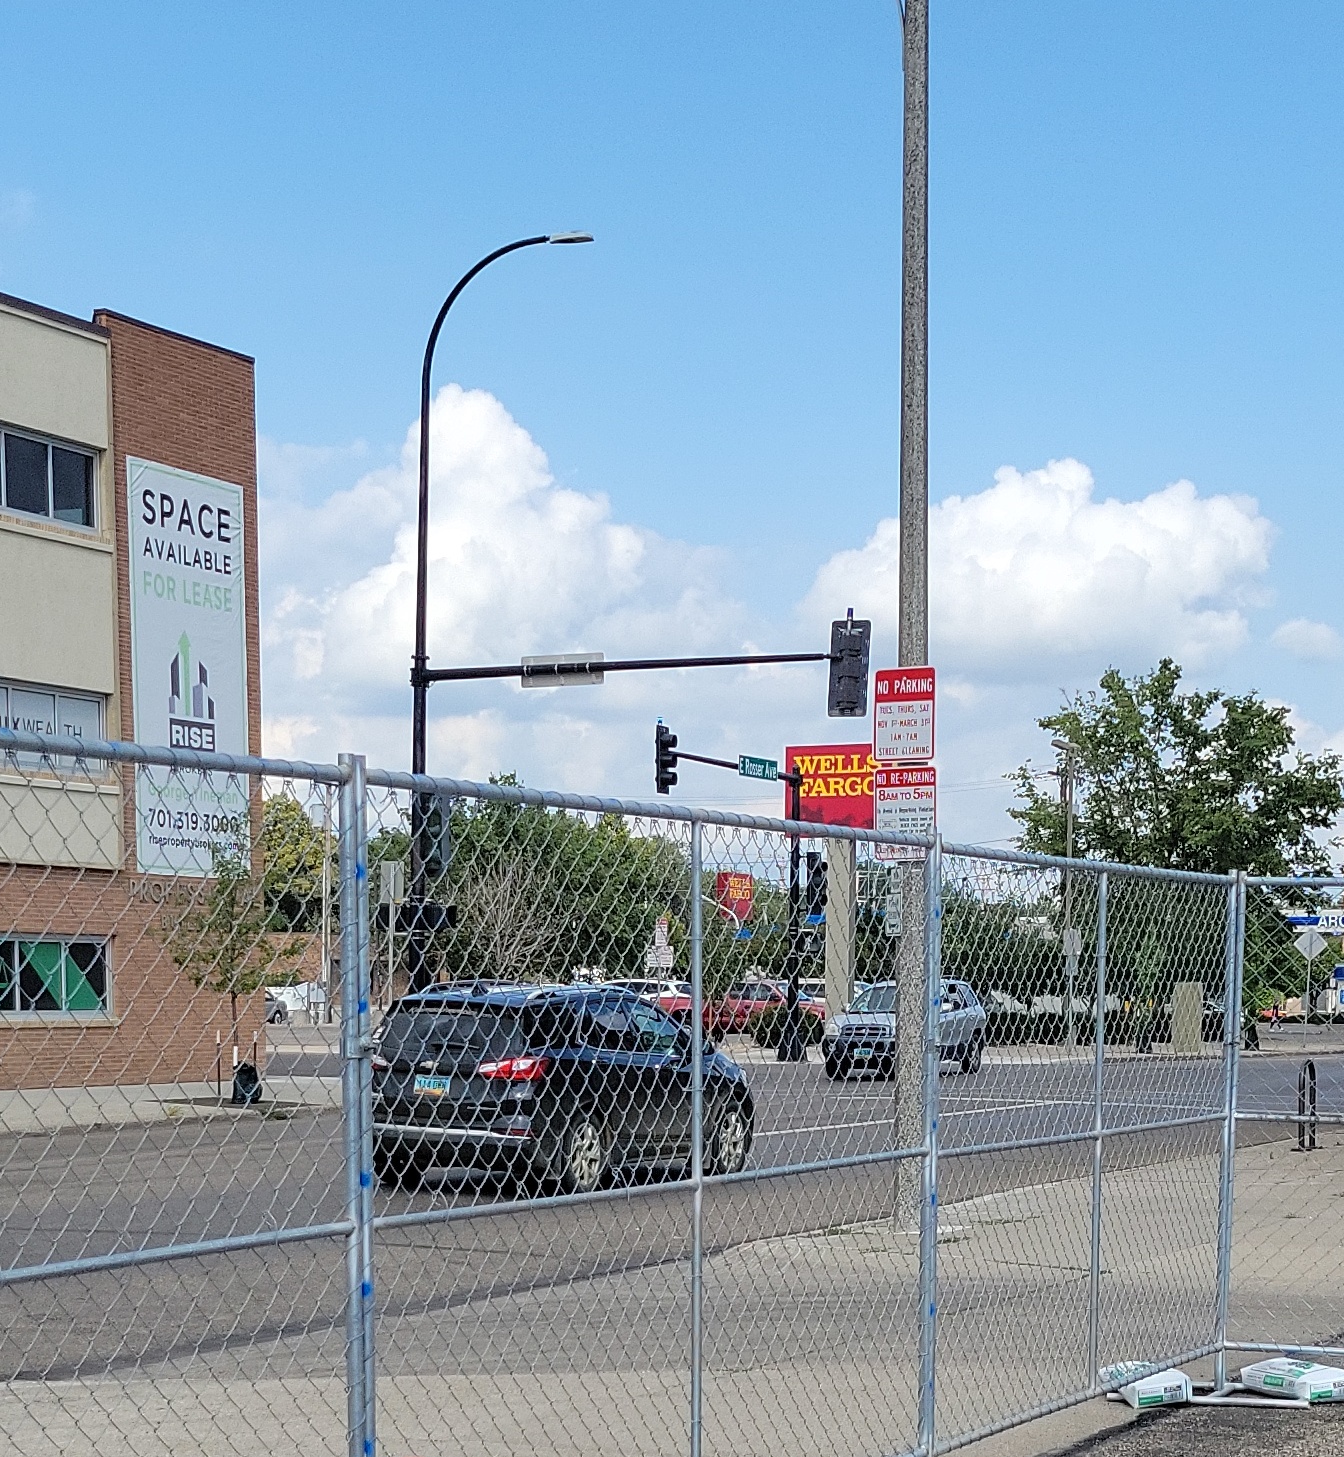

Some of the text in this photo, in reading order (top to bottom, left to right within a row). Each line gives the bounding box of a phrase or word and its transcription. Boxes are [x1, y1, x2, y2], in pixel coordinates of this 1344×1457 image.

[142, 488, 232, 543] SPACE
[142, 536, 232, 576] AVAILABLE
[142, 570, 233, 613] FOR LEASE
[877, 678, 933, 695] NO PARKING
[172, 724, 213, 750] RISE
[878, 748, 899, 756] STREET
[739, 757, 777, 779] E Rosser Ave
[793, 754, 882, 774] WELLS
[799, 777, 875, 797] FARGO
[877, 770, 935, 785] NO RE-PARKING
[878, 788, 933, 801] 8AM TO 5PM
